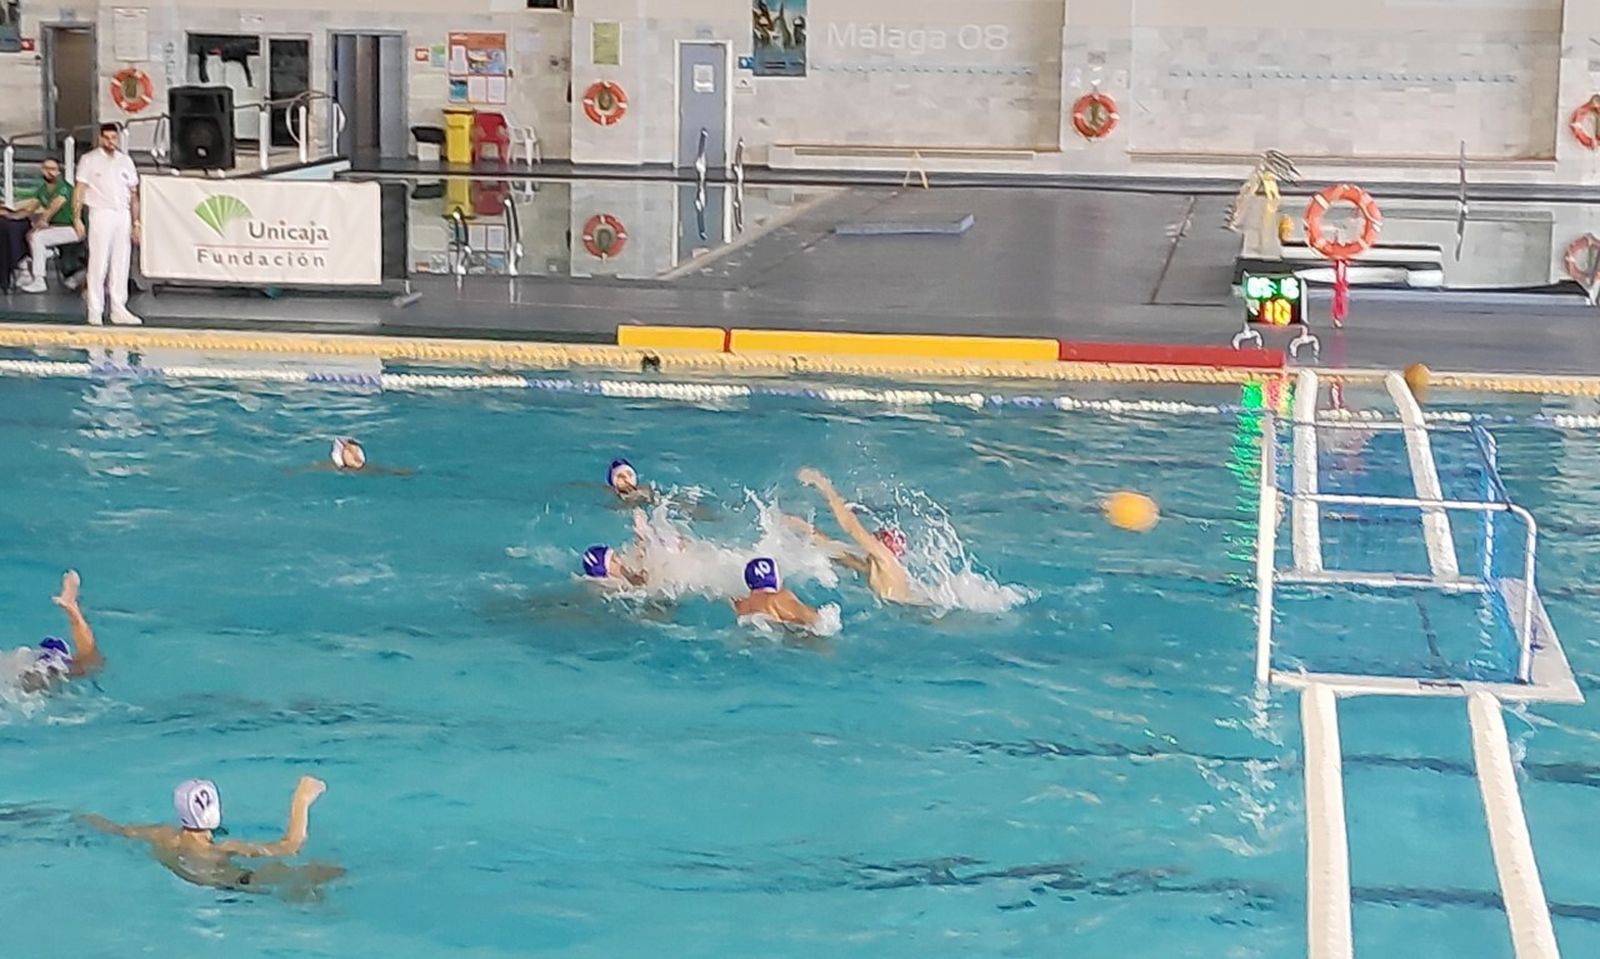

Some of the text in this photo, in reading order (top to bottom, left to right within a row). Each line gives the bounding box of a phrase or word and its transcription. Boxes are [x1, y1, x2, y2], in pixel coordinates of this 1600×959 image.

[958, 23, 1009, 51] 08
[248, 220, 329, 245] Unicaja
[197, 248, 325, 268] Fundación
[754, 560, 771, 580] 10
